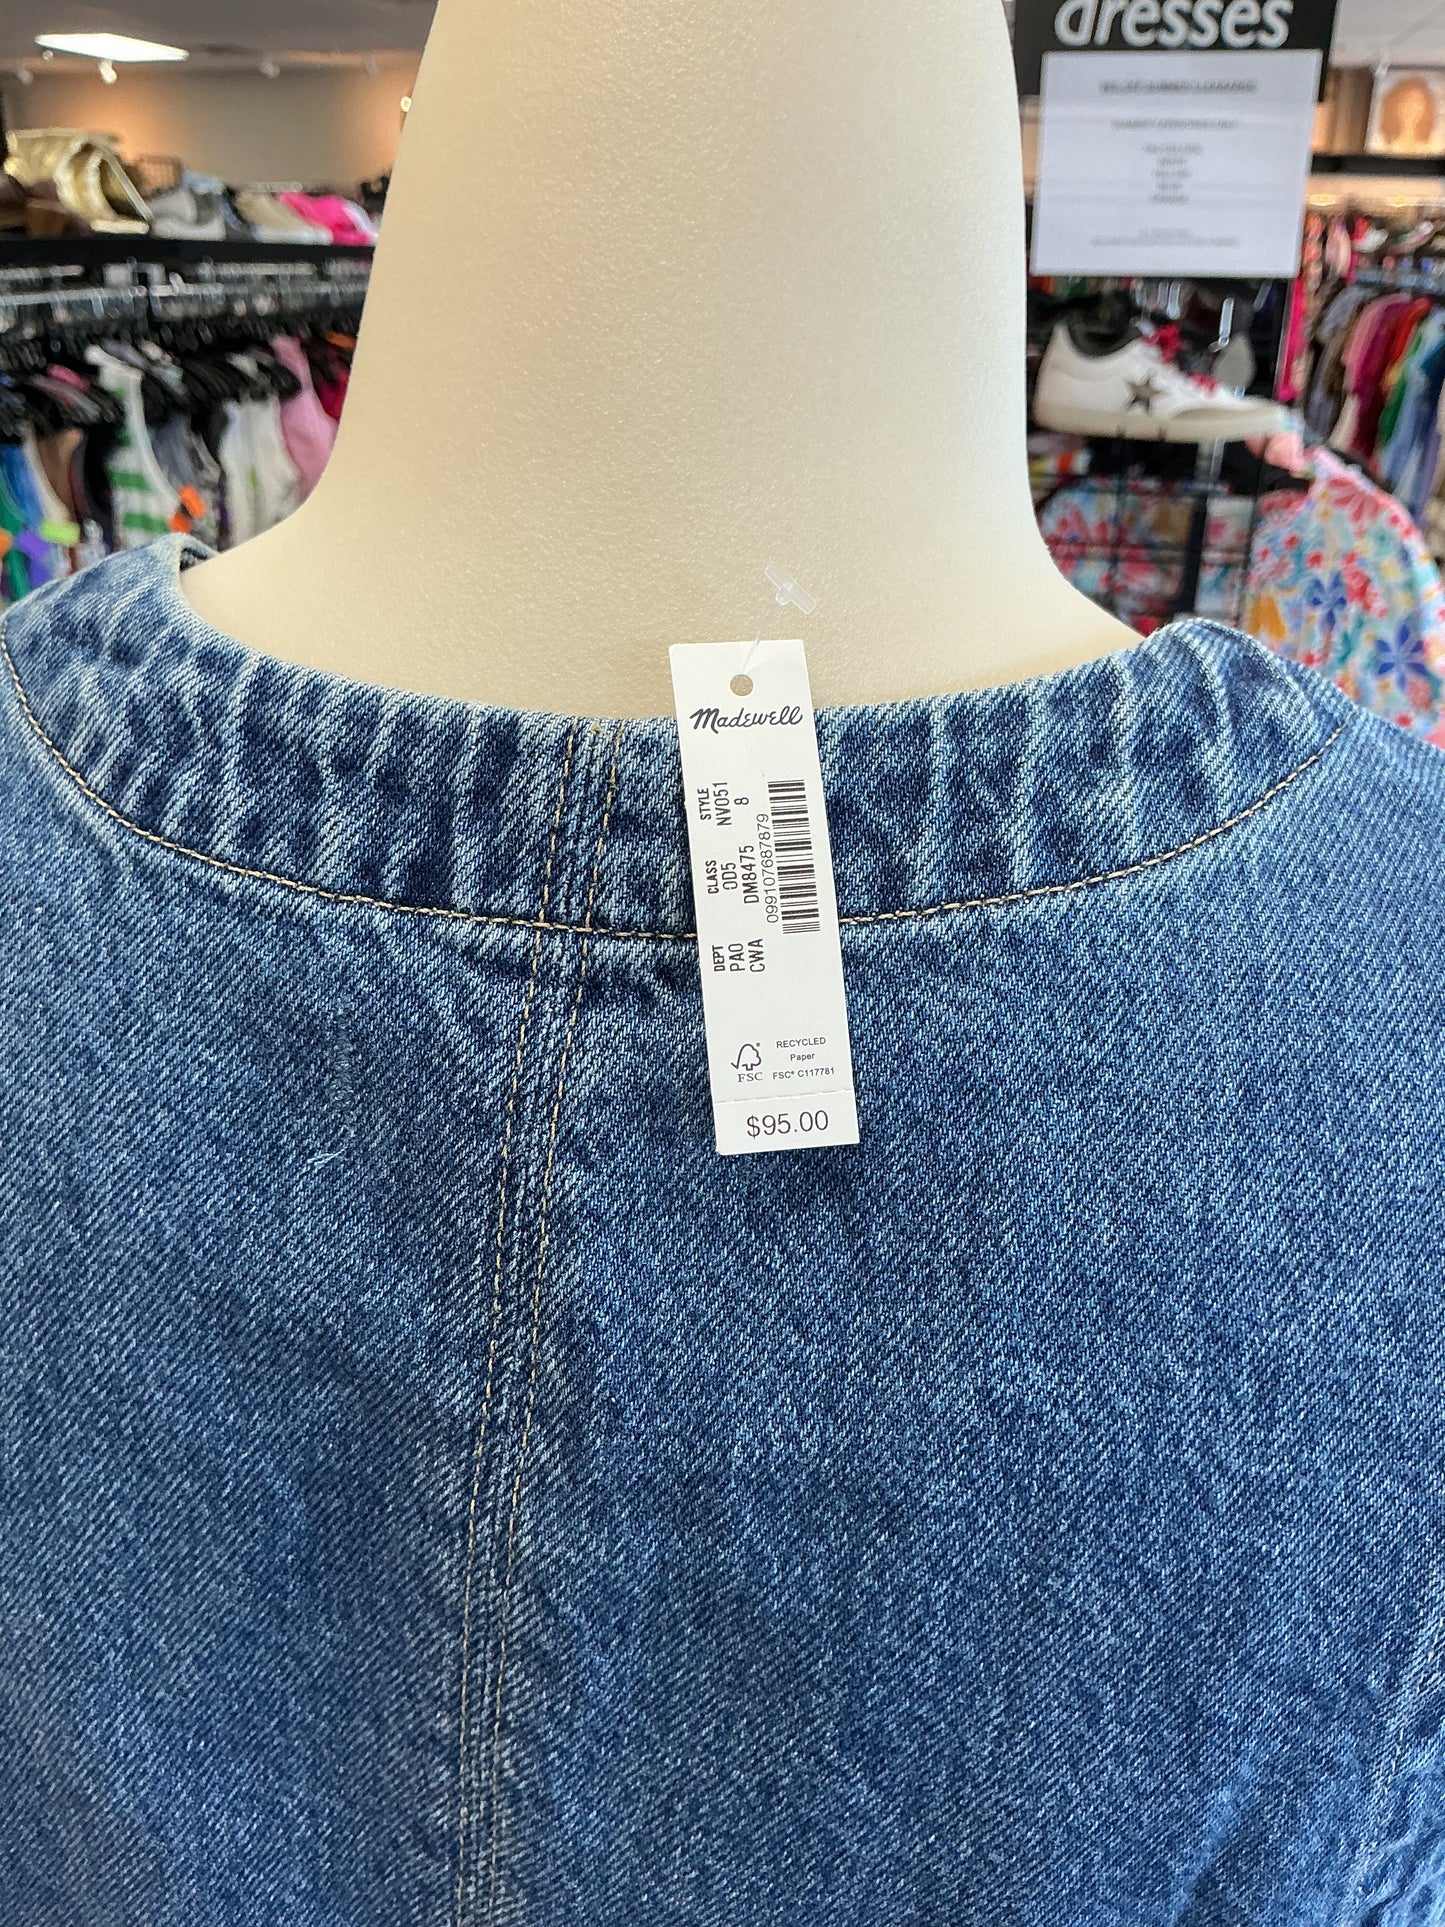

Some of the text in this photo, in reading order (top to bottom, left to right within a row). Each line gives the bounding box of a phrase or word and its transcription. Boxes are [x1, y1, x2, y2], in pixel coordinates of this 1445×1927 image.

[1054, 0, 1295, 48] dresses
[689, 706, 803, 734] Madewell
[712, 782, 732, 826] NV051
[697, 788, 726, 972] DEPT CLASS STYLE
[756, 814, 779, 923] 099107687879
[734, 797, 765, 973] CWA DM8475 8
[776, 1037, 827, 1048] RECYCLED
[789, 1052, 816, 1062] Paper
[737, 1071, 764, 1083] FSC
[797, 1067, 835, 1078] C117781
[747, 1110, 829, 1139] $95.00
